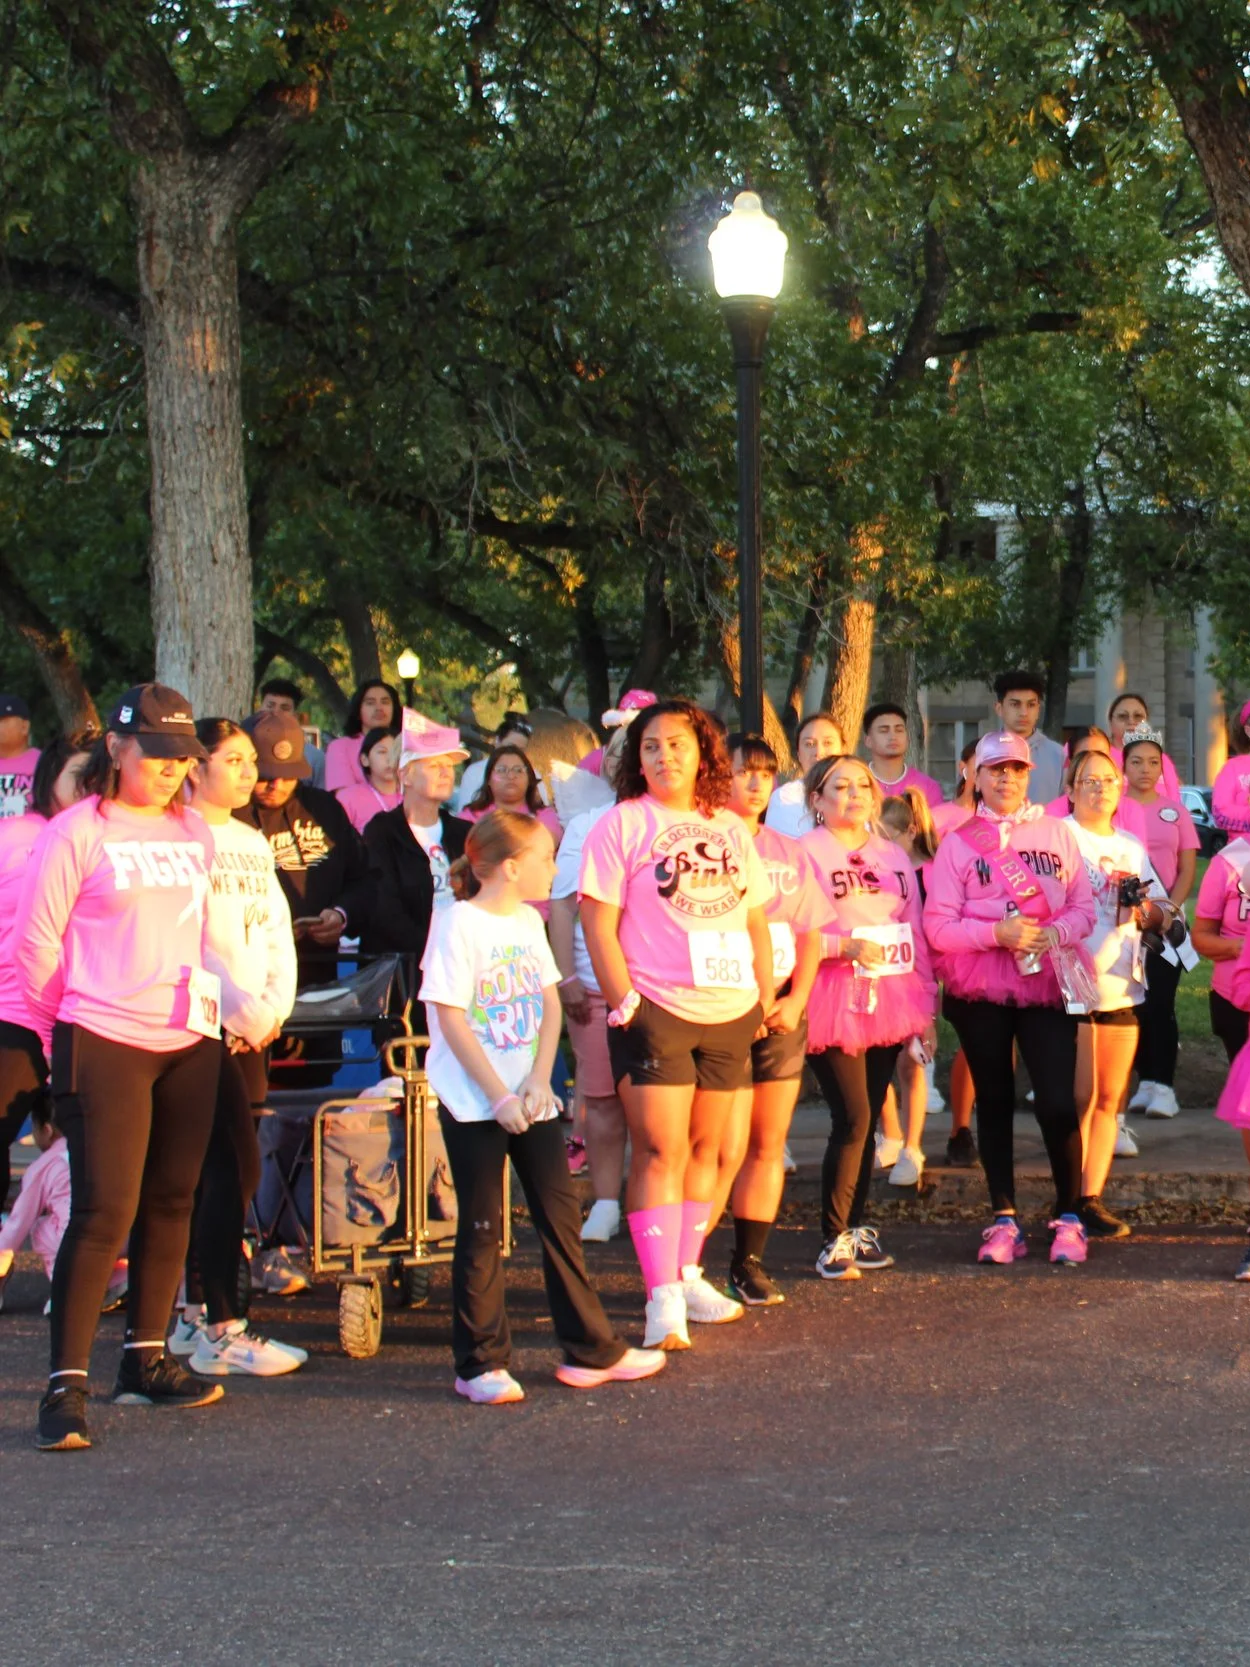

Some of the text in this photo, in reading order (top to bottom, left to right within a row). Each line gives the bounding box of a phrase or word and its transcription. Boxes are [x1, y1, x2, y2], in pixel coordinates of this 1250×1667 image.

[103, 841, 207, 890] FIGHT
[700, 895, 737, 914] WEAR
[705, 957, 742, 983] 583
